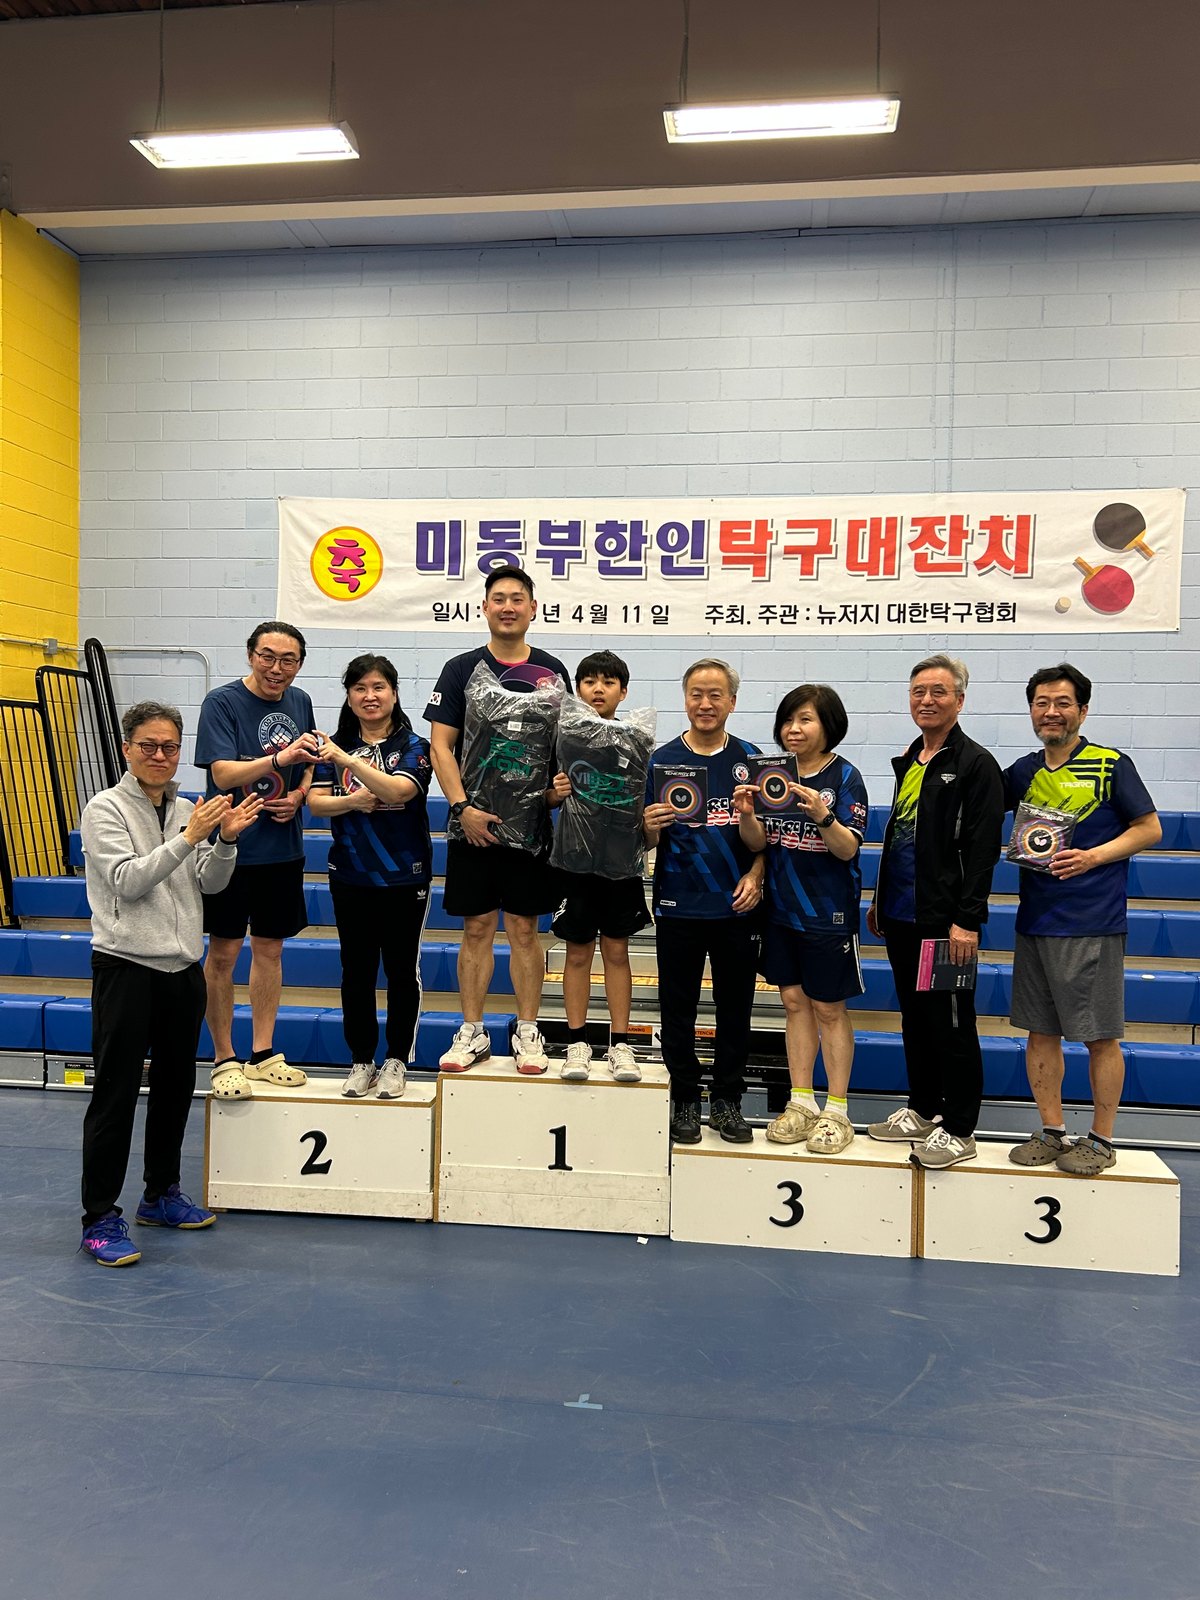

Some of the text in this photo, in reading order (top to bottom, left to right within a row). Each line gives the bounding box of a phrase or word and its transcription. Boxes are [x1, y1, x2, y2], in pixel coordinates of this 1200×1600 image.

[327, 538, 366, 593] 축
[816, 603, 880, 625] 뉴저지
[887, 602, 1017, 624] 대한탁구협회
[299, 1130, 333, 1176] 2
[547, 1124, 574, 1172] 1
[768, 1180, 805, 1228] 3
[1024, 1196, 1062, 1245] 3
